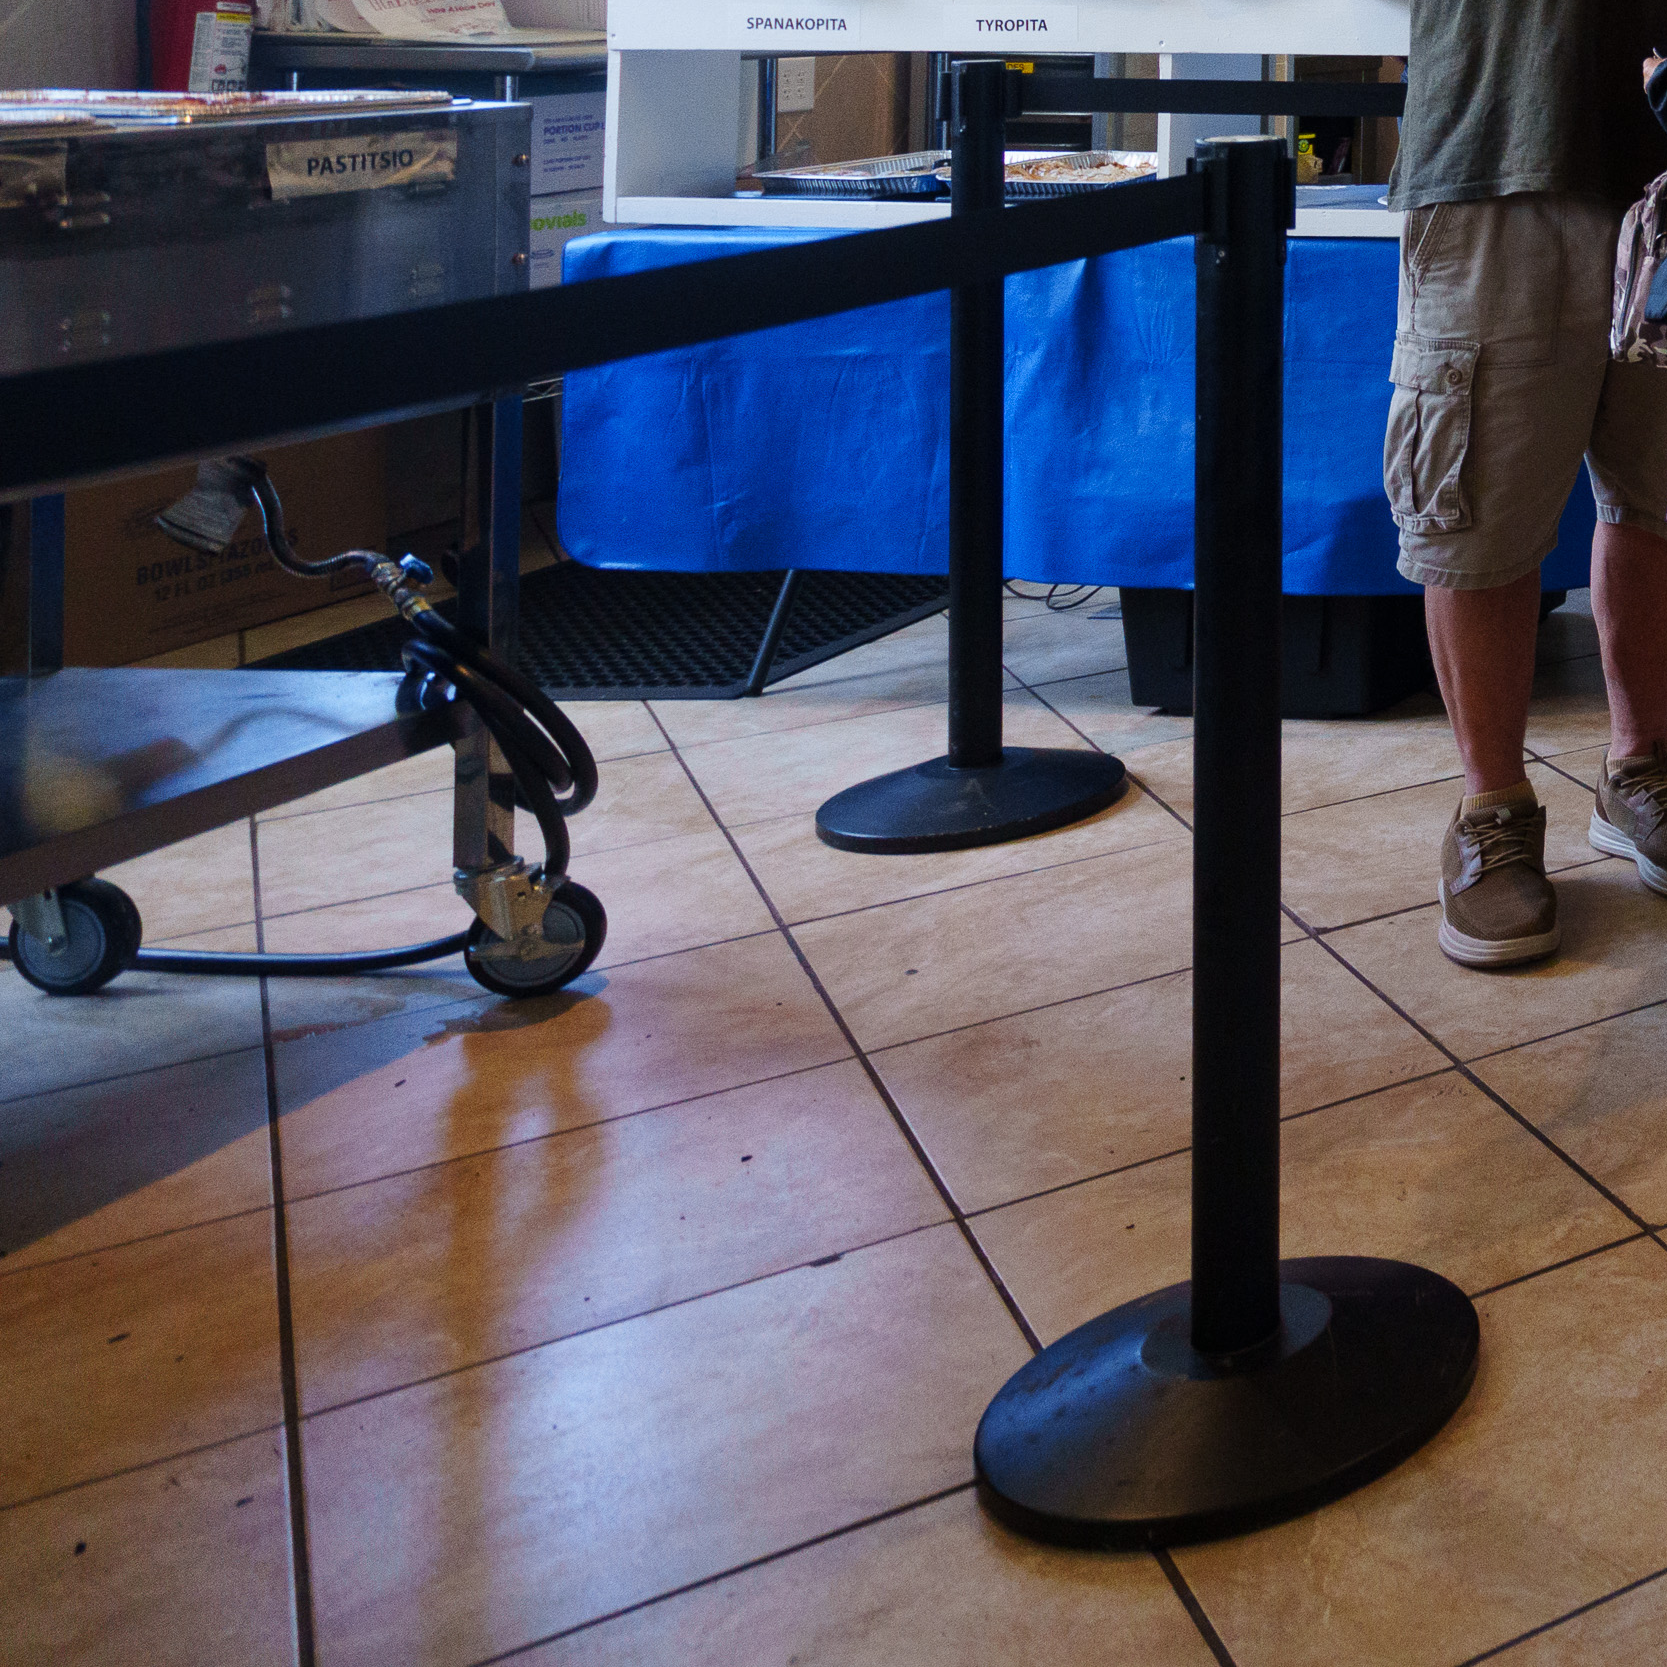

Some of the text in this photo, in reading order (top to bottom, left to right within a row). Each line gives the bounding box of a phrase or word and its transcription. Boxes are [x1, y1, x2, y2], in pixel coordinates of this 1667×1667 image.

[746, 17, 847, 31] SPANAKOPITA
[976, 19, 1048, 32] TYROPITA
[307, 149, 414, 177] PASTITSIO
